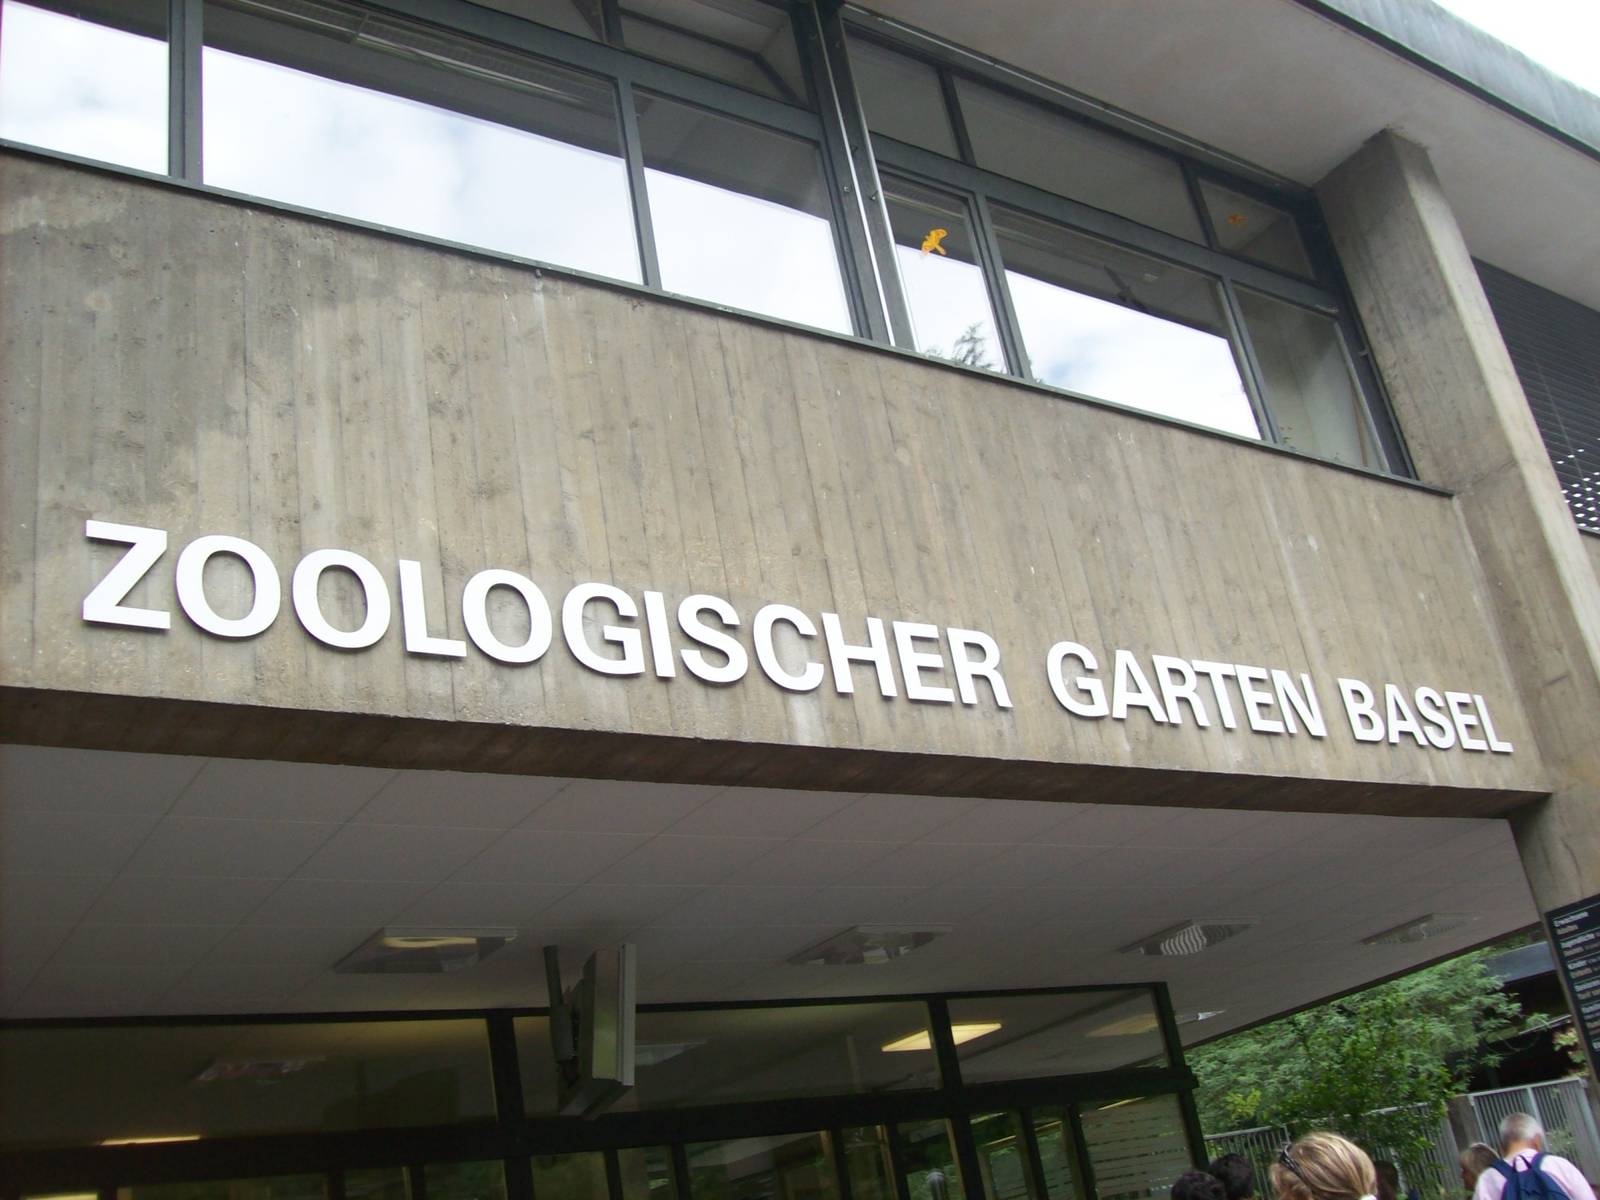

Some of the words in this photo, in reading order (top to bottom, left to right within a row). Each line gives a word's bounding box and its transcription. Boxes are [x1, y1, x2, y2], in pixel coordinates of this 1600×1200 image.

[82, 519, 1013, 709] ZOOLOGISCHER
[1046, 640, 1327, 738] GARTEN
[1337, 678, 1514, 754] BASEL
